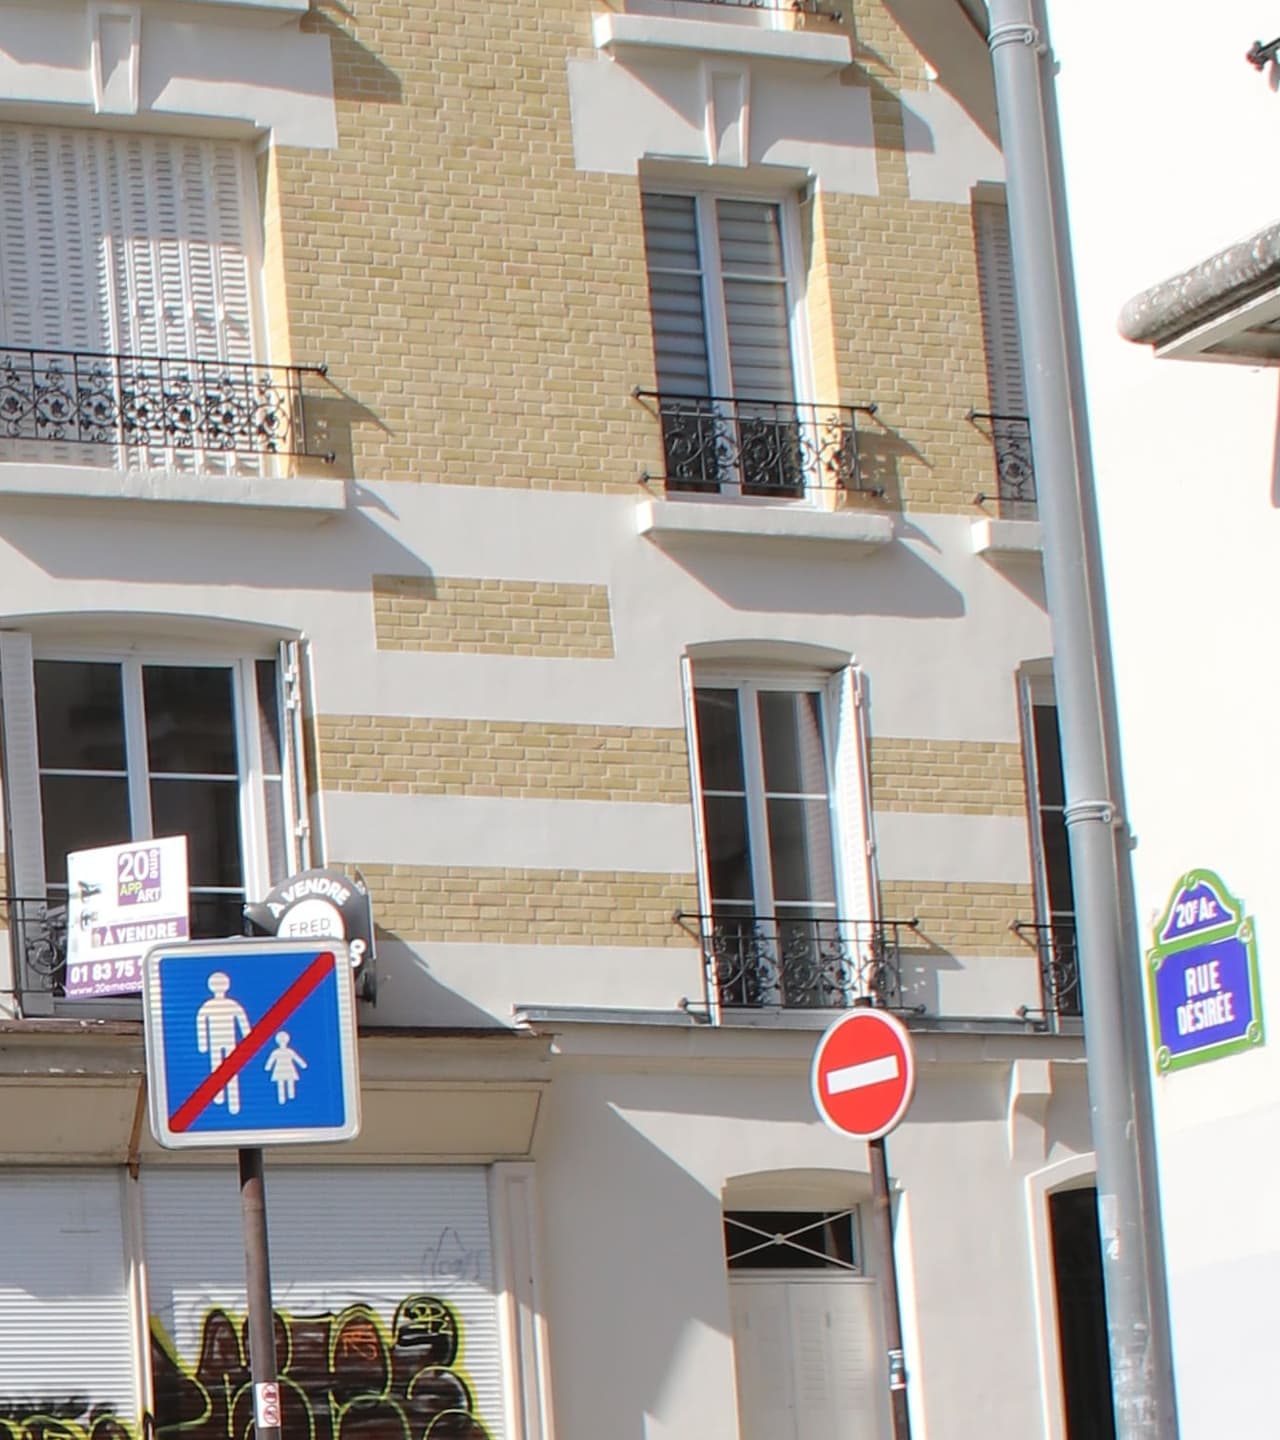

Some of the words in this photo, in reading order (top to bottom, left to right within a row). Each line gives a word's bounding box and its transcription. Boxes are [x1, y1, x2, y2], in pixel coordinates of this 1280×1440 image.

[119, 851, 149, 882] 20
[120, 882, 143, 896] APP
[136, 887, 161, 902] ART
[281, 878, 351, 906] VENDRE
[116, 922, 178, 943] VENDRE
[289, 918, 331, 936] FRED
[71, 965, 89, 983] 01
[116, 960, 135, 978] 75
[1184, 961, 1221, 996] RUE
[1177, 991, 1235, 1036] DÉSIRÉE
